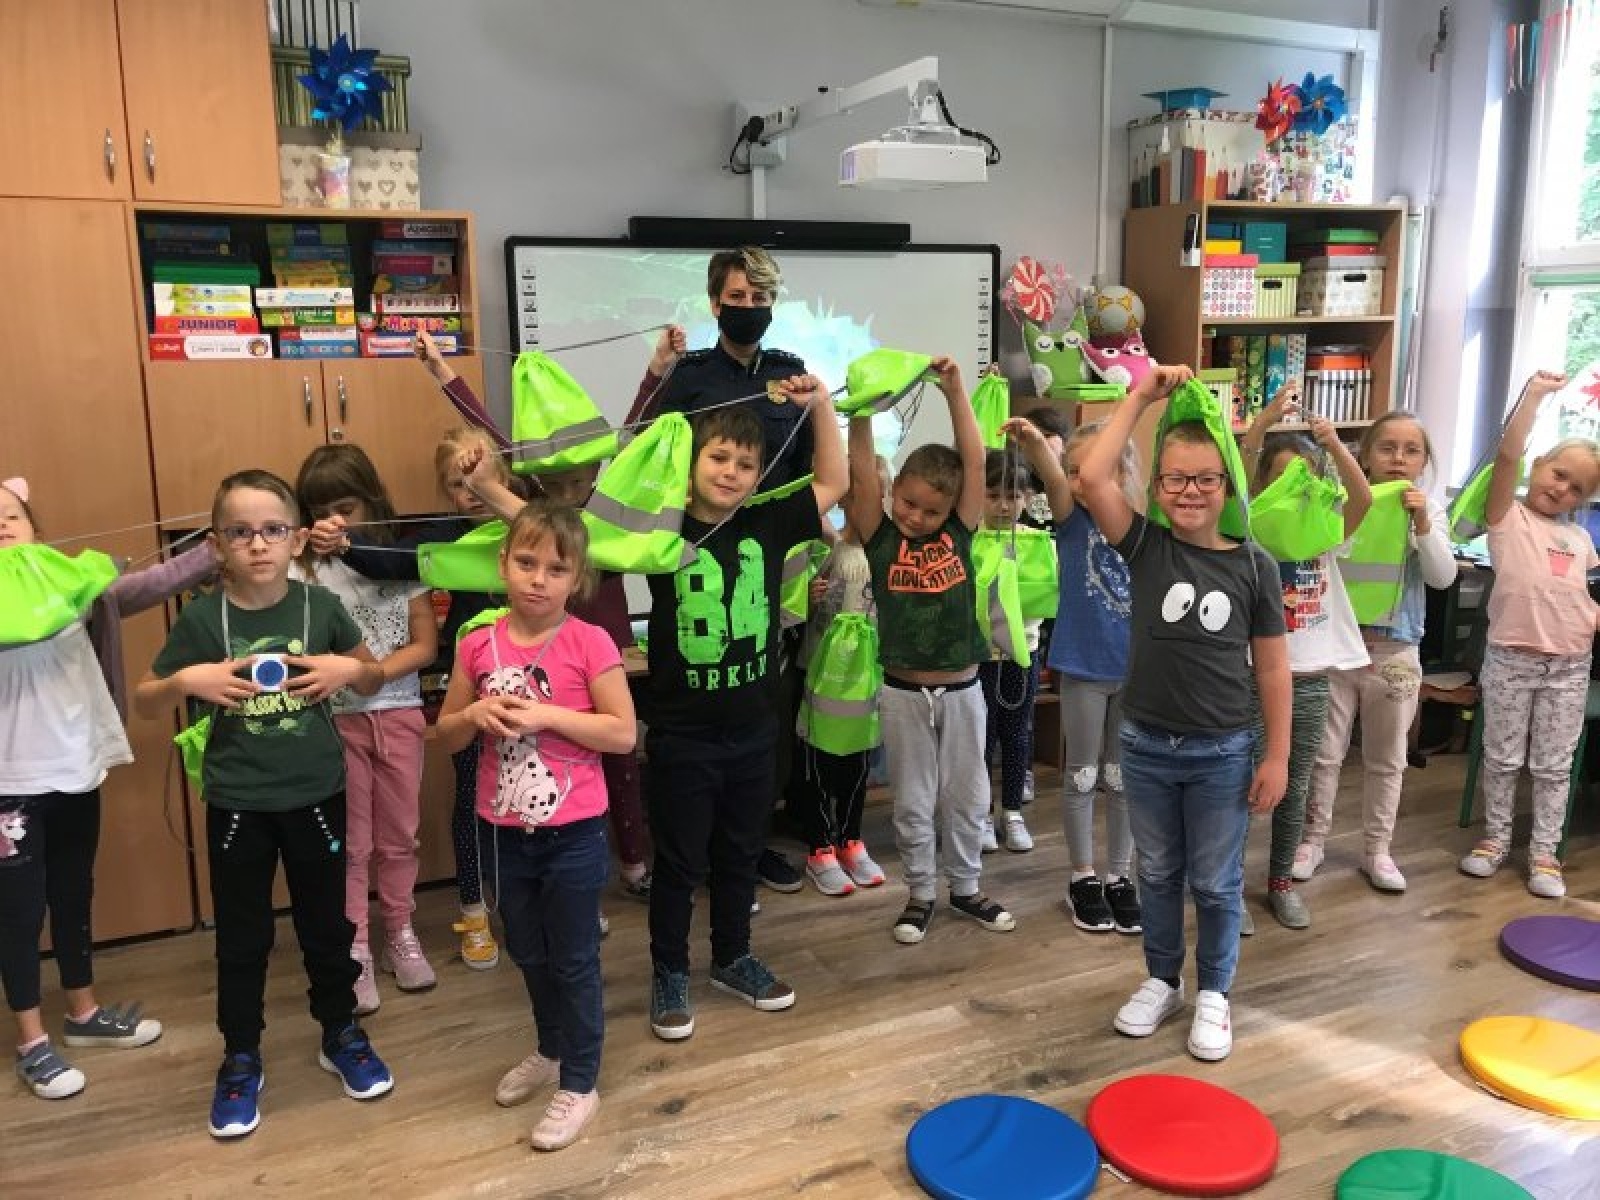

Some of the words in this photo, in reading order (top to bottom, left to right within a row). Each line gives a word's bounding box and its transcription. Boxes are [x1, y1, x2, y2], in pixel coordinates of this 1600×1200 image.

[178, 319, 237, 330] JUNIOR
[674, 538, 770, 664] 84
[686, 653, 766, 690] BRKLN
